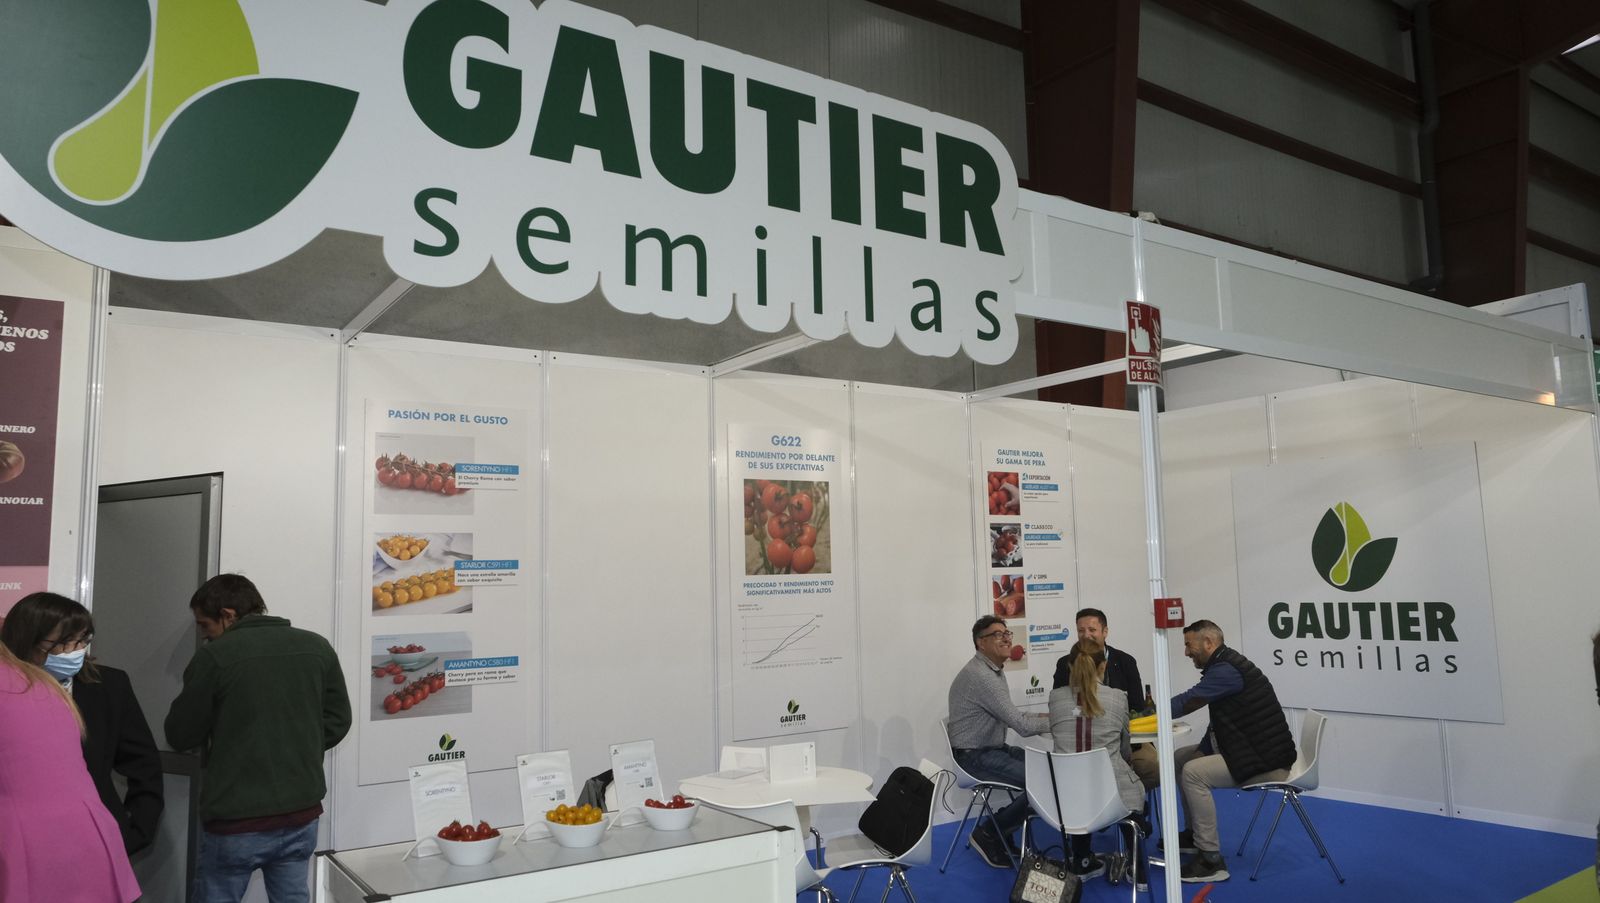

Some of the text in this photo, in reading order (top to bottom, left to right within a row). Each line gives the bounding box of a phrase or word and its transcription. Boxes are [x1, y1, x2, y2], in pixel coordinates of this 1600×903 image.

[403, 0, 1005, 257] GAUTIER
[413, 187, 1001, 342] semillas
[0, 326, 49, 340] ENOS
[1131, 371, 1143, 380] DE
[388, 409, 508, 425] PASIÓN POR EL GUSTO
[771, 435, 802, 447] G622
[736, 450, 836, 462] RENDIMIENTO POR DELANTE
[997, 449, 1020, 457] GAUTIER
[760, 462, 774, 470] SUS
[776, 463, 825, 471] EXPECTATIVAS
[996, 457, 1004, 465] SU
[1005, 458, 1022, 466] GAMA
[1268, 602, 1459, 642] GAUTIER
[1273, 645, 1458, 673] semillas
[780, 714, 807, 723] GAUTIER
[428, 750, 466, 762] GAUTIER
[1031, 882, 1057, 897] TOUS
